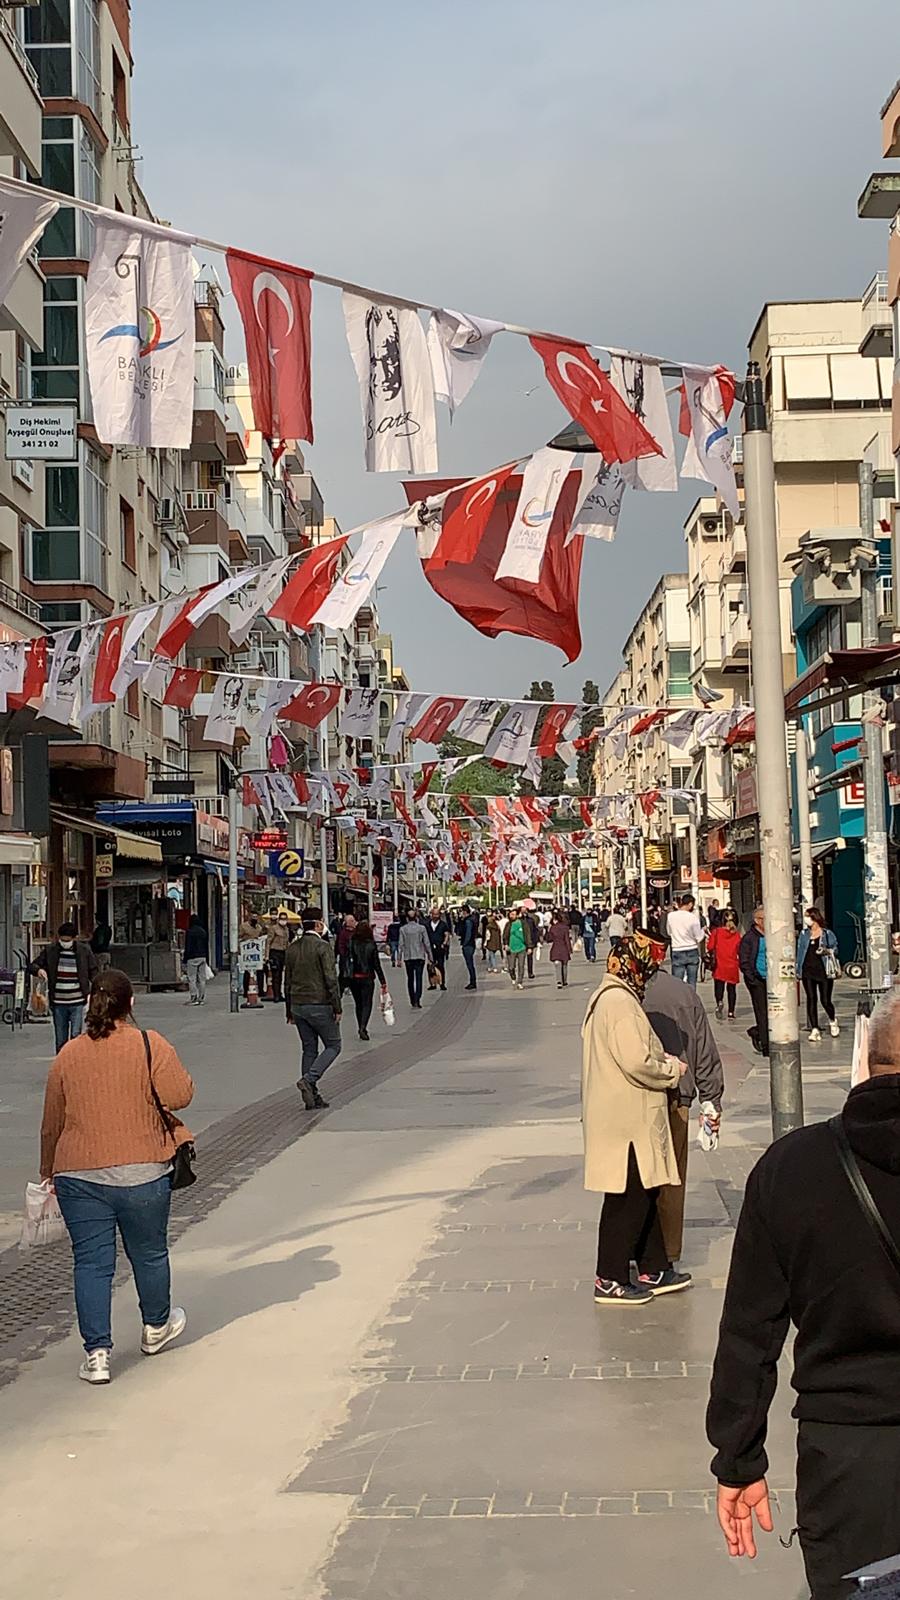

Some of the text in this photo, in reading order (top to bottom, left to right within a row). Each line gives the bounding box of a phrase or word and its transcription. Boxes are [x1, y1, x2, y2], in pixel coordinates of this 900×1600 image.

[7, 428, 38, 438] Ayşegül
[22, 440, 59, 448] 341 21 02
[161, 829, 182, 837] Loto
